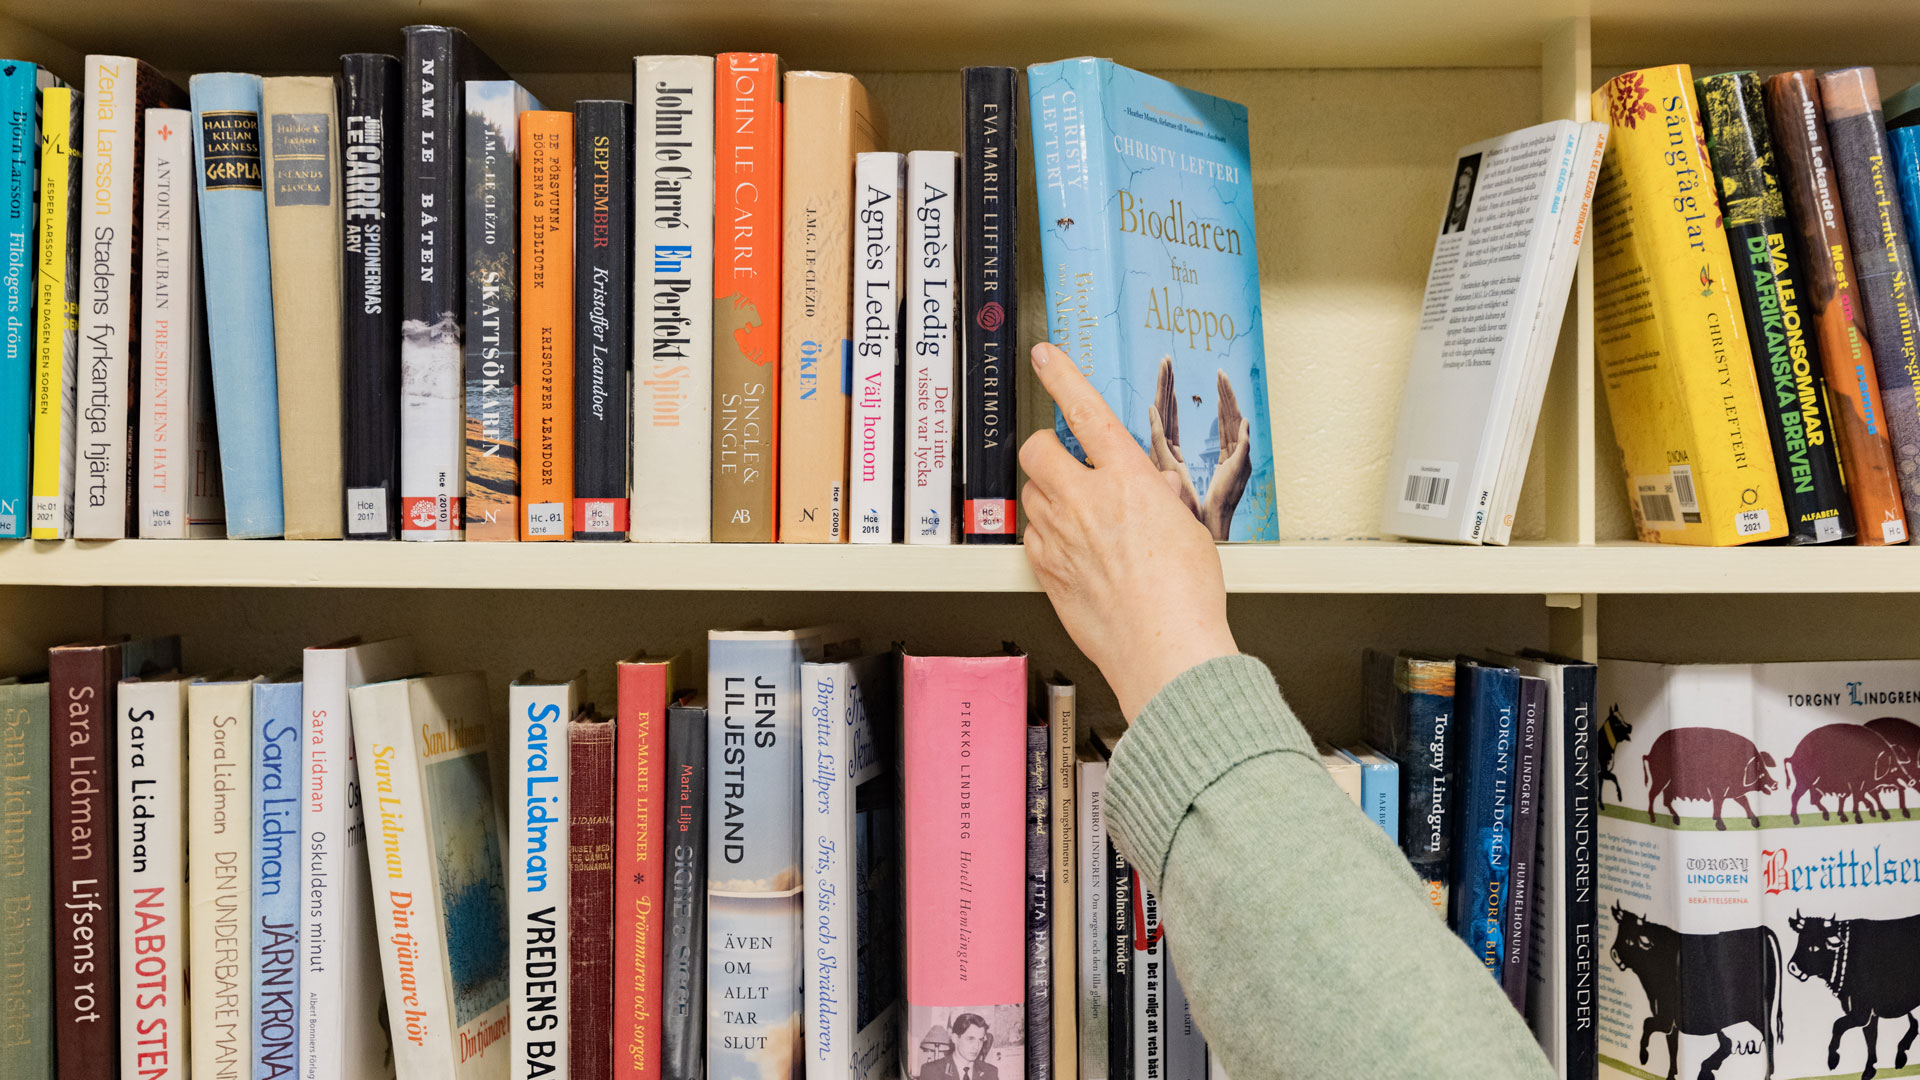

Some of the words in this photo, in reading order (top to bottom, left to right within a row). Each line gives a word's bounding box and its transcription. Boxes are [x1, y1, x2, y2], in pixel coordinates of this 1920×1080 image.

[97, 64, 119, 120] Zenia
[655, 81, 693, 136] John
[1802, 100, 1820, 141] Nina
[208, 143, 258, 152] LAXNESS
[212, 131, 252, 141] KILIAN
[346, 116, 364, 144] LE
[364, 116, 381, 144] JOHN
[982, 103, 999, 205] EVA-MARIE
[1042, 93, 1062, 191] LEFTERI
[1061, 90, 1082, 189] CHRISTY
[1113, 135, 1176, 168] CHRISTY
[1180, 153, 1239, 185] LEFTERI
[10, 159, 27, 219] Larsson
[45, 177, 54, 214] JESPER
[95, 129, 117, 215] Larsson
[157, 157, 170, 231] ANTOINE
[207, 162, 261, 180] GERPLA
[346, 145, 386, 220] CARRÉ
[533, 133, 544, 207] BÖCKERNAS
[549, 157, 560, 232] FÖRSVUNNA
[593, 135, 610, 249] SEPTEMBER
[654, 165, 693, 229] Carré
[1810, 146, 1837, 229] Lekander
[1868, 154, 1887, 199] Peter
[346, 224, 361, 253] ARV
[421, 193, 437, 283] BÅTEN
[484, 195, 499, 245] CLÉZIO
[733, 182, 759, 280] CARRÉ
[860, 184, 892, 270] Agnès
[916, 181, 948, 269] Agnès
[1118, 189, 1243, 256] Biodlaren
[93, 227, 115, 315] Stadens
[363, 224, 382, 315] SPIONERNAS
[654, 244, 692, 274] En
[982, 213, 999, 292] LIFFNER
[1171, 256, 1199, 285] från
[1661, 95, 1706, 253] Sångfåglar
[1706, 312, 1732, 387] CHRISTY
[1722, 394, 1748, 470] LEFTERI
[1767, 232, 1790, 276] EVA
[1829, 244, 1849, 289] Mest
[590, 265, 609, 341] Kristoffer
[652, 277, 692, 362] Perfekt
[804, 269, 819, 318] CLÉZIO
[858, 280, 890, 358] Ledig
[915, 278, 948, 357] Ledig
[1074, 271, 1098, 377] Biodlaren
[1144, 286, 1234, 352] Aleppo
[84, 324, 115, 433] fyrkantiga
[482, 271, 504, 458] SKATTSÖKAREN
[541, 327, 553, 410] KRISTOFFER
[592, 344, 608, 421] Leandoer
[799, 340, 822, 401] ÖKEN
[859, 371, 882, 409] Välj
[917, 367, 931, 411] visste
[1754, 269, 1797, 409] AFRIKANSKA
[1780, 411, 1815, 494] BREVEN
[1778, 278, 1824, 448] LEJONSOMMAR
[643, 364, 691, 428] Spion
[743, 382, 765, 465] SINGLE
[934, 386, 948, 414] Det
[983, 342, 999, 450] LACRIMOSA
[1854, 364, 1878, 436] mamma
[721, 393, 742, 475] SINGLE
[862, 415, 882, 483] honom
[84, 443, 111, 507] hjärta
[357, 501, 374, 509] Hce
[37, 513, 54, 521] 2021
[357, 513, 374, 521] 2017
[439, 493, 447, 523] (2010)
[731, 509, 751, 524] AB
[831, 507, 840, 537] (2008)
[862, 526, 880, 534] 2018
[863, 515, 879, 523] Hce
[1470, 510, 1484, 540] (2008)
[1742, 512, 1759, 520] Hce
[1743, 522, 1761, 532] 2021
[1800, 508, 1839, 523] ALFABETA
[68, 686, 95, 748] Sara
[311, 709, 327, 746] Sara
[754, 675, 776, 749] JENS
[811, 676, 835, 747] Birgitta
[960, 701, 971, 758] PIRKKO
[1787, 693, 1841, 707] TORGNY
[4, 707, 31, 768] Sara
[128, 707, 155, 769] Sara
[213, 715, 238, 760] Sara
[262, 718, 297, 792] Sara
[371, 743, 395, 794] Sara
[422, 723, 447, 758] Sara
[527, 701, 561, 773] Sara
[636, 711, 650, 792] EVA-MARIE
[1059, 746, 1072, 789] Lindgren
[1428, 713, 1448, 772] Torgny
[1495, 705, 1512, 775] TORGNY
[1574, 701, 1589, 790] TORGNY
[213, 763, 237, 835] Lidman
[311, 750, 328, 813] Lidman
[679, 764, 693, 801] Maria
[724, 677, 745, 864] LILJESTRAND
[960, 764, 971, 840] LINDBERG
[70, 756, 100, 860] Lidman
[131, 779, 157, 873] Lidman
[377, 796, 405, 879] Lidman
[526, 776, 559, 893] Lidman
[635, 797, 649, 863] LIFFNER
[1090, 791, 1100, 832] BARBRO
[1426, 776, 1445, 853] Lindgren
[1491, 779, 1507, 866] LINDGREN
[261, 798, 297, 897] Lidman
[310, 831, 328, 918] Oskuldens
[959, 850, 972, 893] Hotell
[1574, 795, 1590, 903] LINDGREN
[1686, 857, 1749, 873] TORGNY
[1687, 874, 1748, 884] LINDGREN
[64, 878, 102, 974] Lifsens
[1034, 869, 1047, 921] TITTA
[1115, 876, 1129, 931] Molnens
[1511, 861, 1526, 964] HUMMELHONUNG
[1688, 896, 1749, 905] BERÄTTELSERNA
[133, 887, 167, 1010] NABOTS
[215, 894, 239, 1021] UNDERBARE
[310, 923, 326, 973] minut
[390, 932, 419, 1007] tjänare
[525, 906, 559, 1032] VREDENS
[634, 895, 652, 992] Drömmaren
[723, 933, 773, 950] ÄVEN
[724, 961, 752, 975] OM
[74, 982, 101, 1023] rot
[723, 986, 769, 1000] ALLT
[1145, 993, 1159, 1018] roligt
[1575, 923, 1591, 1032] LEGENDER
[308, 1018, 318, 1053] Bonniers
[459, 1029, 477, 1064] Din
[628, 1023, 646, 1071] sorgen
[723, 1011, 758, 1025] TAR
[723, 1036, 768, 1050] SLUT
